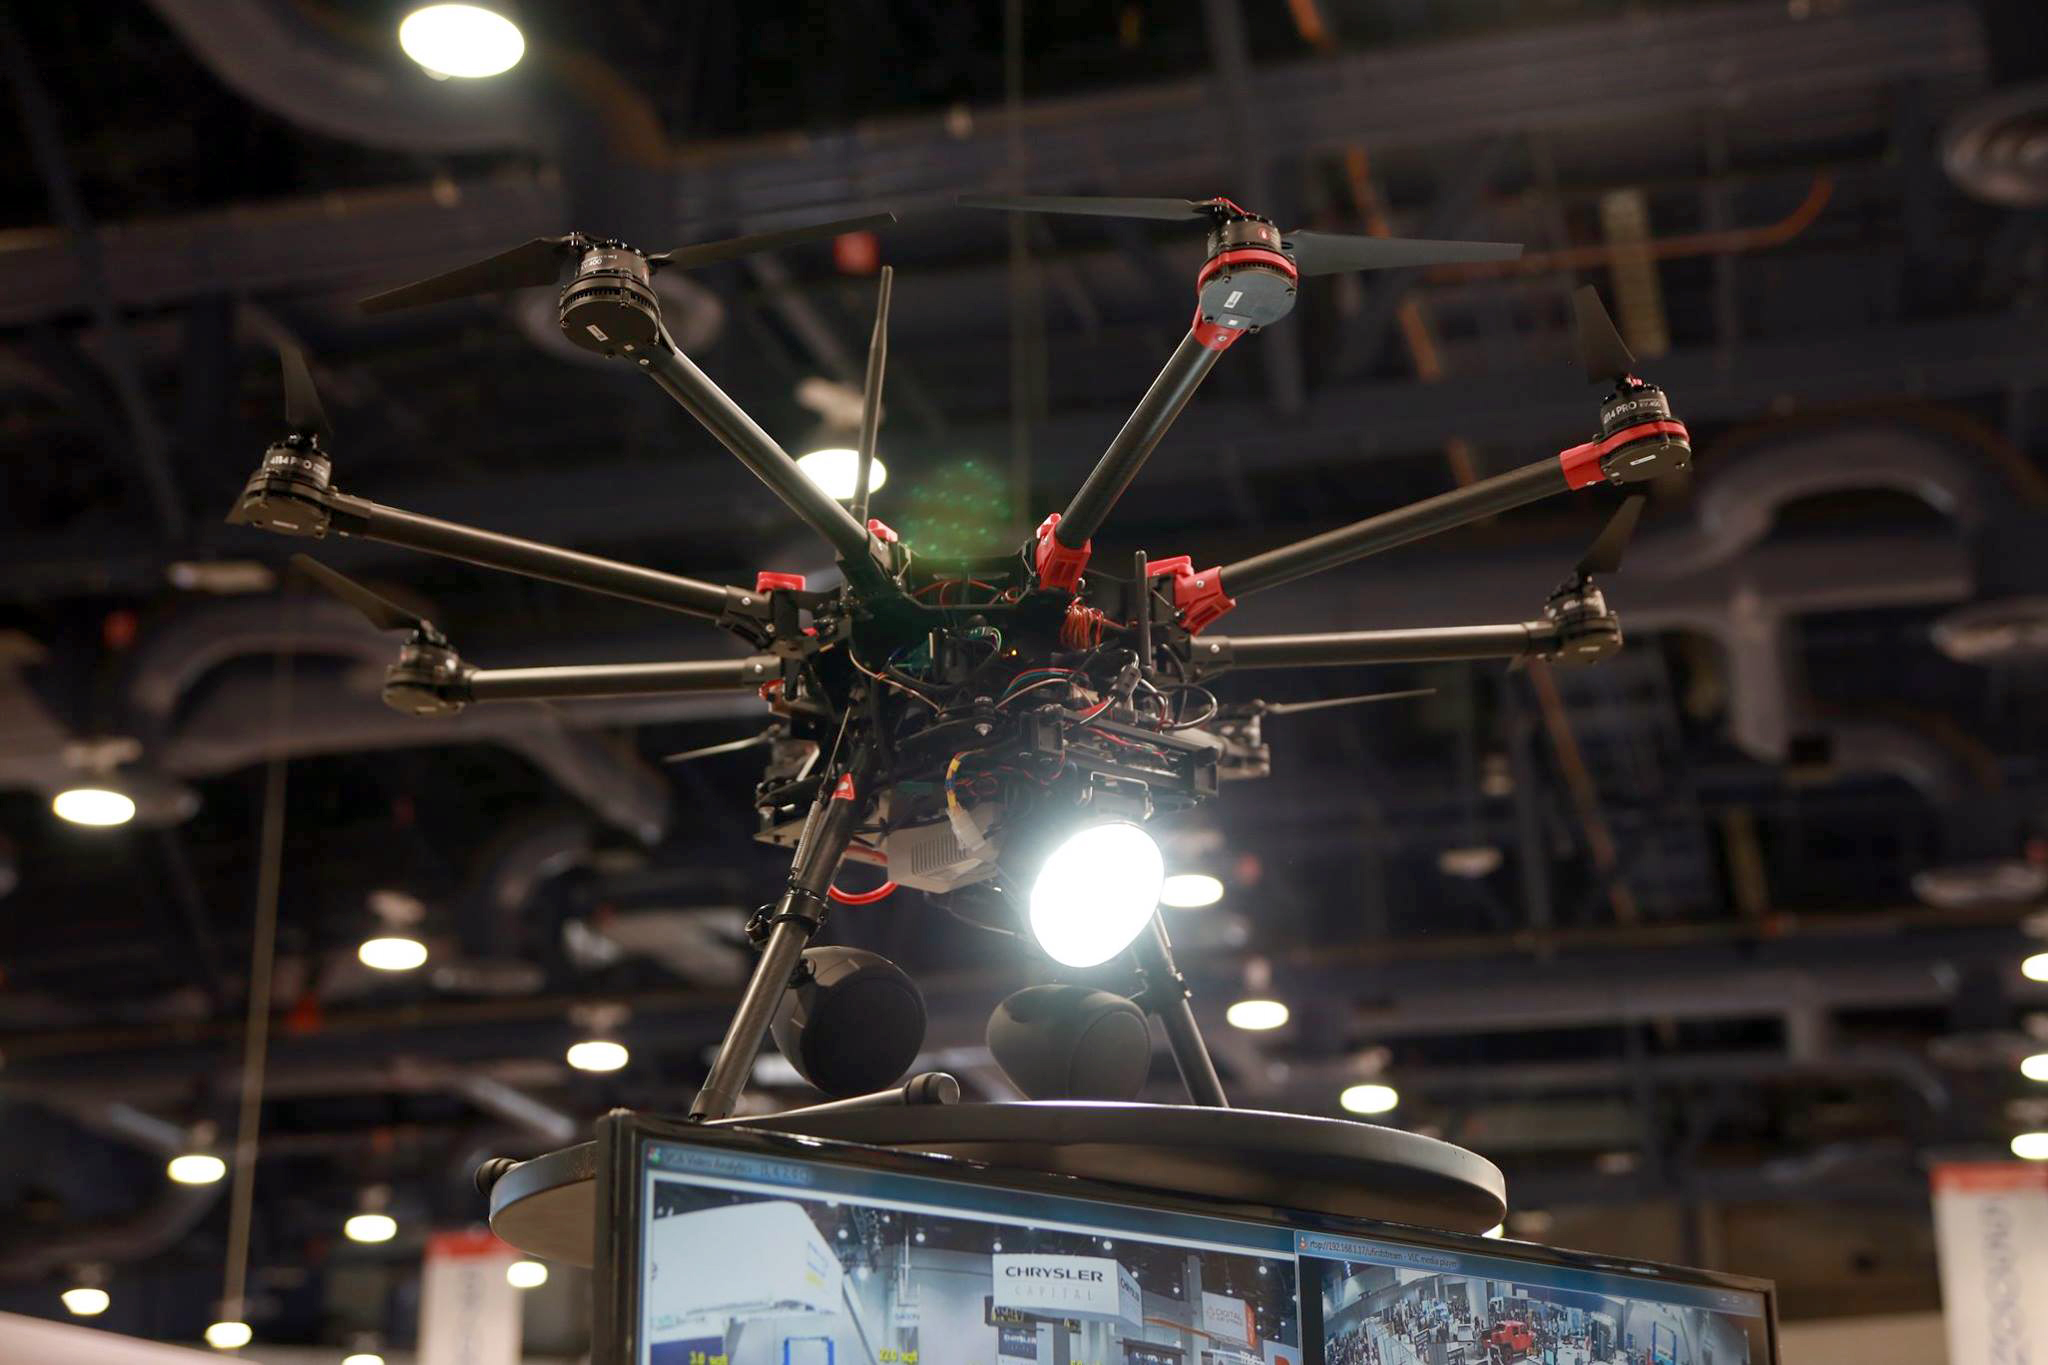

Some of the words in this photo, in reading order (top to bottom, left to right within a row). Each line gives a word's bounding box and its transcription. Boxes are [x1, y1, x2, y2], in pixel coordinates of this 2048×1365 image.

[1616, 401, 1638, 416] PRO
[1005, 1266, 1104, 1282] CHRYSLER
[1015, 1286, 1093, 1301] CAPITAL
